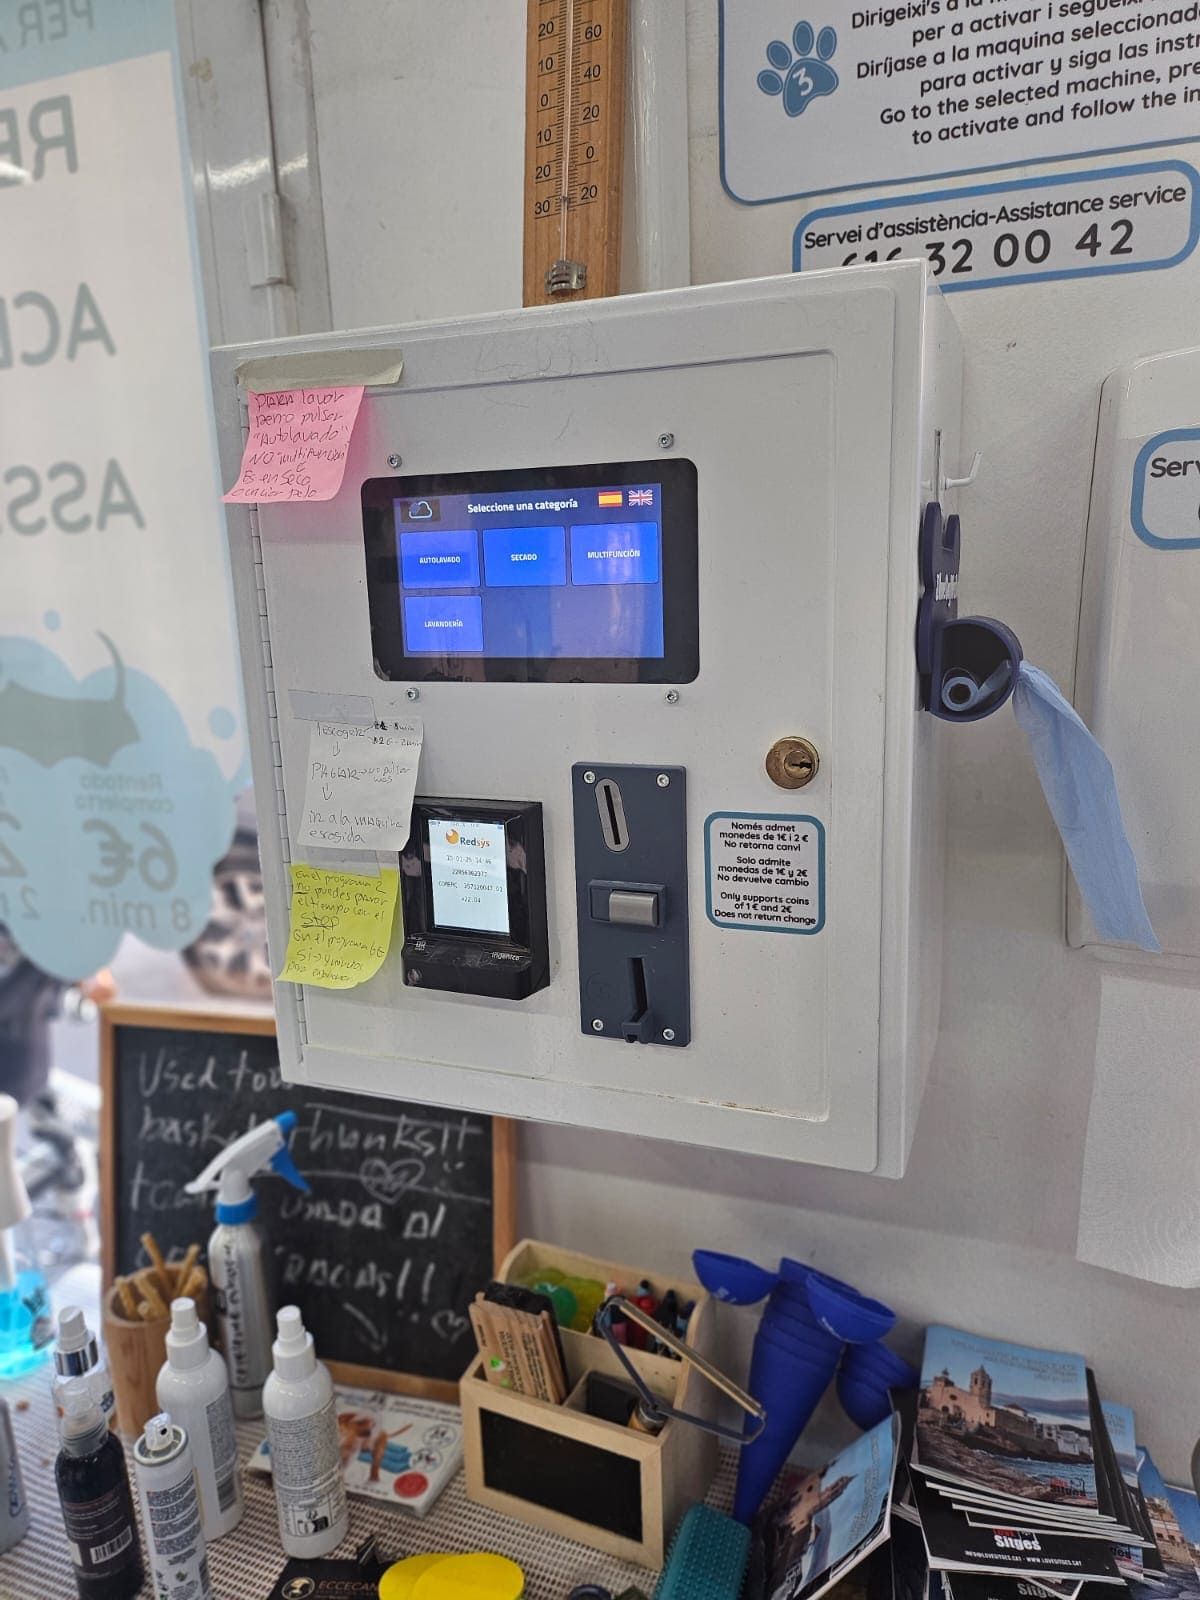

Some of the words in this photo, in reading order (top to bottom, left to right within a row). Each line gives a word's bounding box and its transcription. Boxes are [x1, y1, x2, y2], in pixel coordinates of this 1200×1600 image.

[852, 0, 941, 29] Dirigeixi's
[539, 21, 554, 37] 20
[585, 24, 602, 41] 60
[912, 25, 945, 48] per
[951, 22, 963, 36] a
[970, 8, 1041, 33] activar
[1048, 2, 1052, 19] i
[857, 54, 927, 79] Diríjase
[933, 51, 945, 65] a
[952, 45, 969, 62] la
[976, 30, 1064, 58] maquina
[1071, 2, 1200, 42] seleccionad
[539, 57, 553, 71] 10
[920, 73, 966, 97] para
[973, 60, 1043, 85] activar
[1050, 57, 1062, 75] y
[1068, 49, 1111, 69] siga
[1118, 43, 1148, 60] las
[584, 64, 601, 80] 40
[792, 67, 813, 97] 3
[541, 93, 549, 108] 0
[880, 108, 906, 125] Go
[911, 104, 931, 120] to
[938, 97, 969, 116] the
[975, 80, 1059, 110] selected
[1066, 69, 1161, 95] machine,
[583, 104, 600, 121] 20
[912, 129, 932, 145] to
[938, 116, 1018, 141] activate
[1025, 105, 1064, 127] and
[1071, 98, 1135, 120] follow
[1141, 91, 1176, 109] the
[536, 129, 552, 144] 10
[586, 146, 594, 160] 0
[536, 165, 551, 180] 20
[581, 184, 598, 201] 20
[535, 200, 550, 215] 30
[804, 225, 862, 249] Servei
[1109, 185, 1186, 210] service
[925, 239, 973, 277] 32
[993, 229, 1051, 268] 00
[1075, 219, 1133, 258] 42
[467, 501, 514, 513] Seleccione
[516, 502, 533, 512] una
[535, 498, 578, 511] categoría
[419, 556, 461, 565] AUTOLAVADO
[510, 553, 537, 561] SECADO
[587, 549, 641, 559] MULTIFUNCIÓN
[731, 822, 762, 831] Només
[765, 823, 795, 832] admet
[460, 837, 490, 848] Redsys
[720, 832, 760, 841] monedes
[763, 833, 774, 841] de
[724, 840, 736, 848] No
[739, 841, 774, 850] retorna
[776, 843, 801, 852] canvi
[736, 856, 756, 865] Solo
[758, 858, 791, 867] admite
[718, 865, 759, 874] monedas
[761, 867, 773, 875] de
[788, 870, 794, 878] y
[796, 869, 808, 877] 2€
[717, 874, 730, 882] No
[732, 875, 772, 884] devuelve
[775, 877, 809, 887] cambio
[720, 892, 740, 902] Only
[742, 893, 783, 904] supports
[785, 897, 810, 905] coins
[734, 902, 745, 910] of
[761, 904, 778, 913] and
[715, 909, 735, 918] Does
[738, 911, 752, 919] not
[754, 912, 781, 922] return
[783, 914, 816, 925] change
